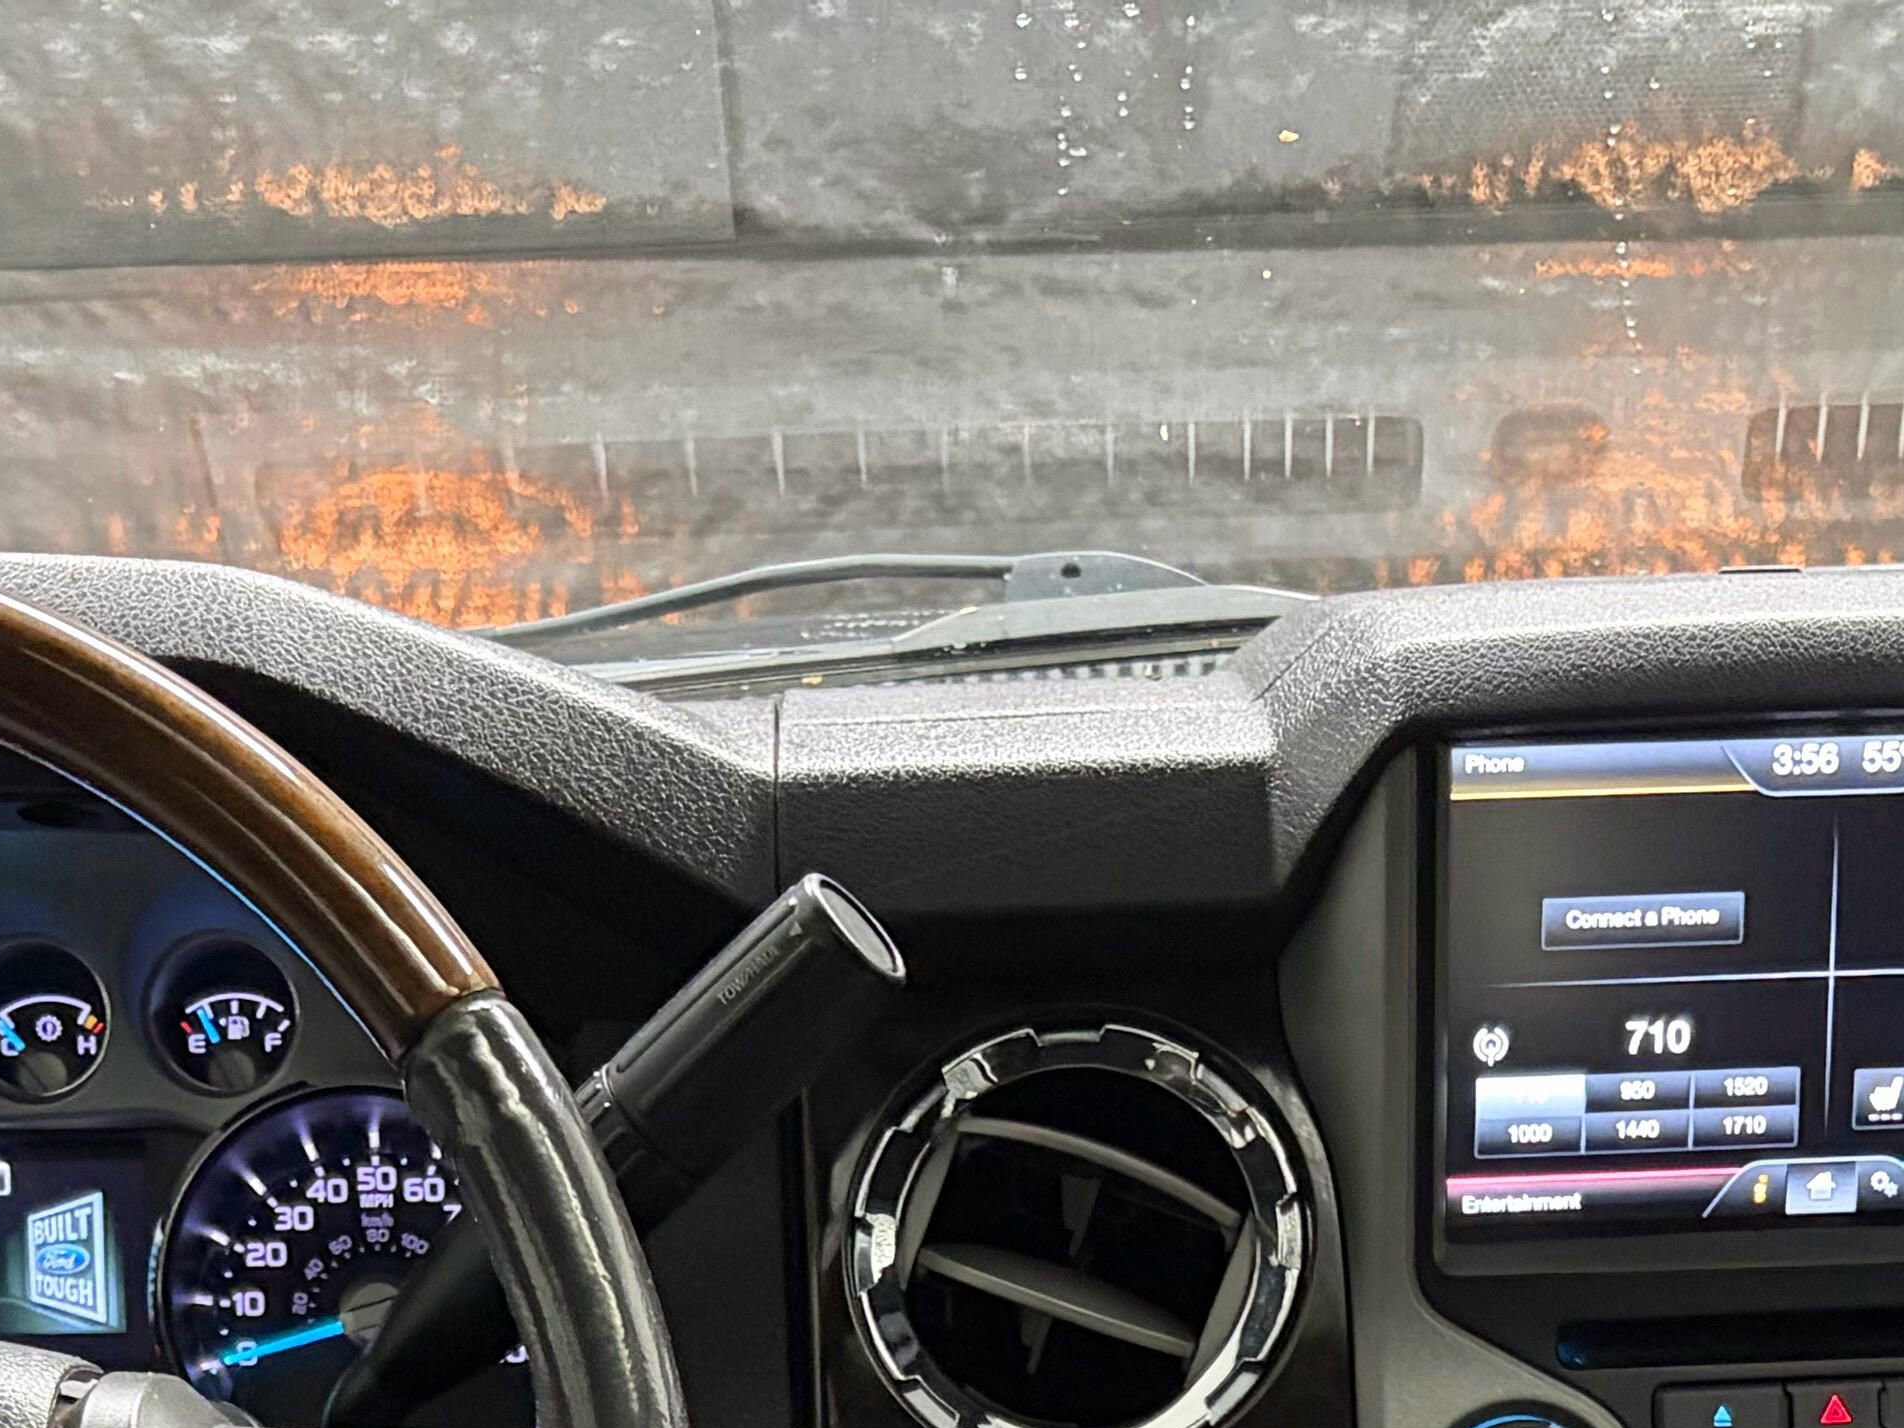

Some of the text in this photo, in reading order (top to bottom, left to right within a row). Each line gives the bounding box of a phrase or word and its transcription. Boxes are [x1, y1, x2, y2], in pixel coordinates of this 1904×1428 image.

[1465, 754, 1525, 774] Phone
[1772, 742, 1840, 775] 3:56
[1565, 904, 1720, 930] Connect a Phone
[77, 1035, 96, 1056] H
[187, 1033, 207, 1054] E
[264, 1032, 283, 1053] F
[1624, 1019, 1692, 1056] 710
[1723, 1075, 1769, 1097] 1520
[1508, 1123, 1553, 1144] 1000
[1616, 1118, 1660, 1140] 1440
[1723, 1114, 1767, 1136] 1710
[306, 1177, 349, 1203] 40
[356, 1166, 397, 1192] 50
[402, 1176, 445, 1203] 60
[359, 1193, 394, 1208] MPH
[1461, 1193, 1582, 1214] Entertainment
[34, 1206, 92, 1245] BUILT
[274, 1205, 314, 1232] 30
[366, 1228, 390, 1243] 80
[400, 1232, 430, 1255] 100
[244, 1241, 287, 1268] 20
[34, 1273, 93, 1307] TOUGH
[232, 1290, 266, 1317] 10
